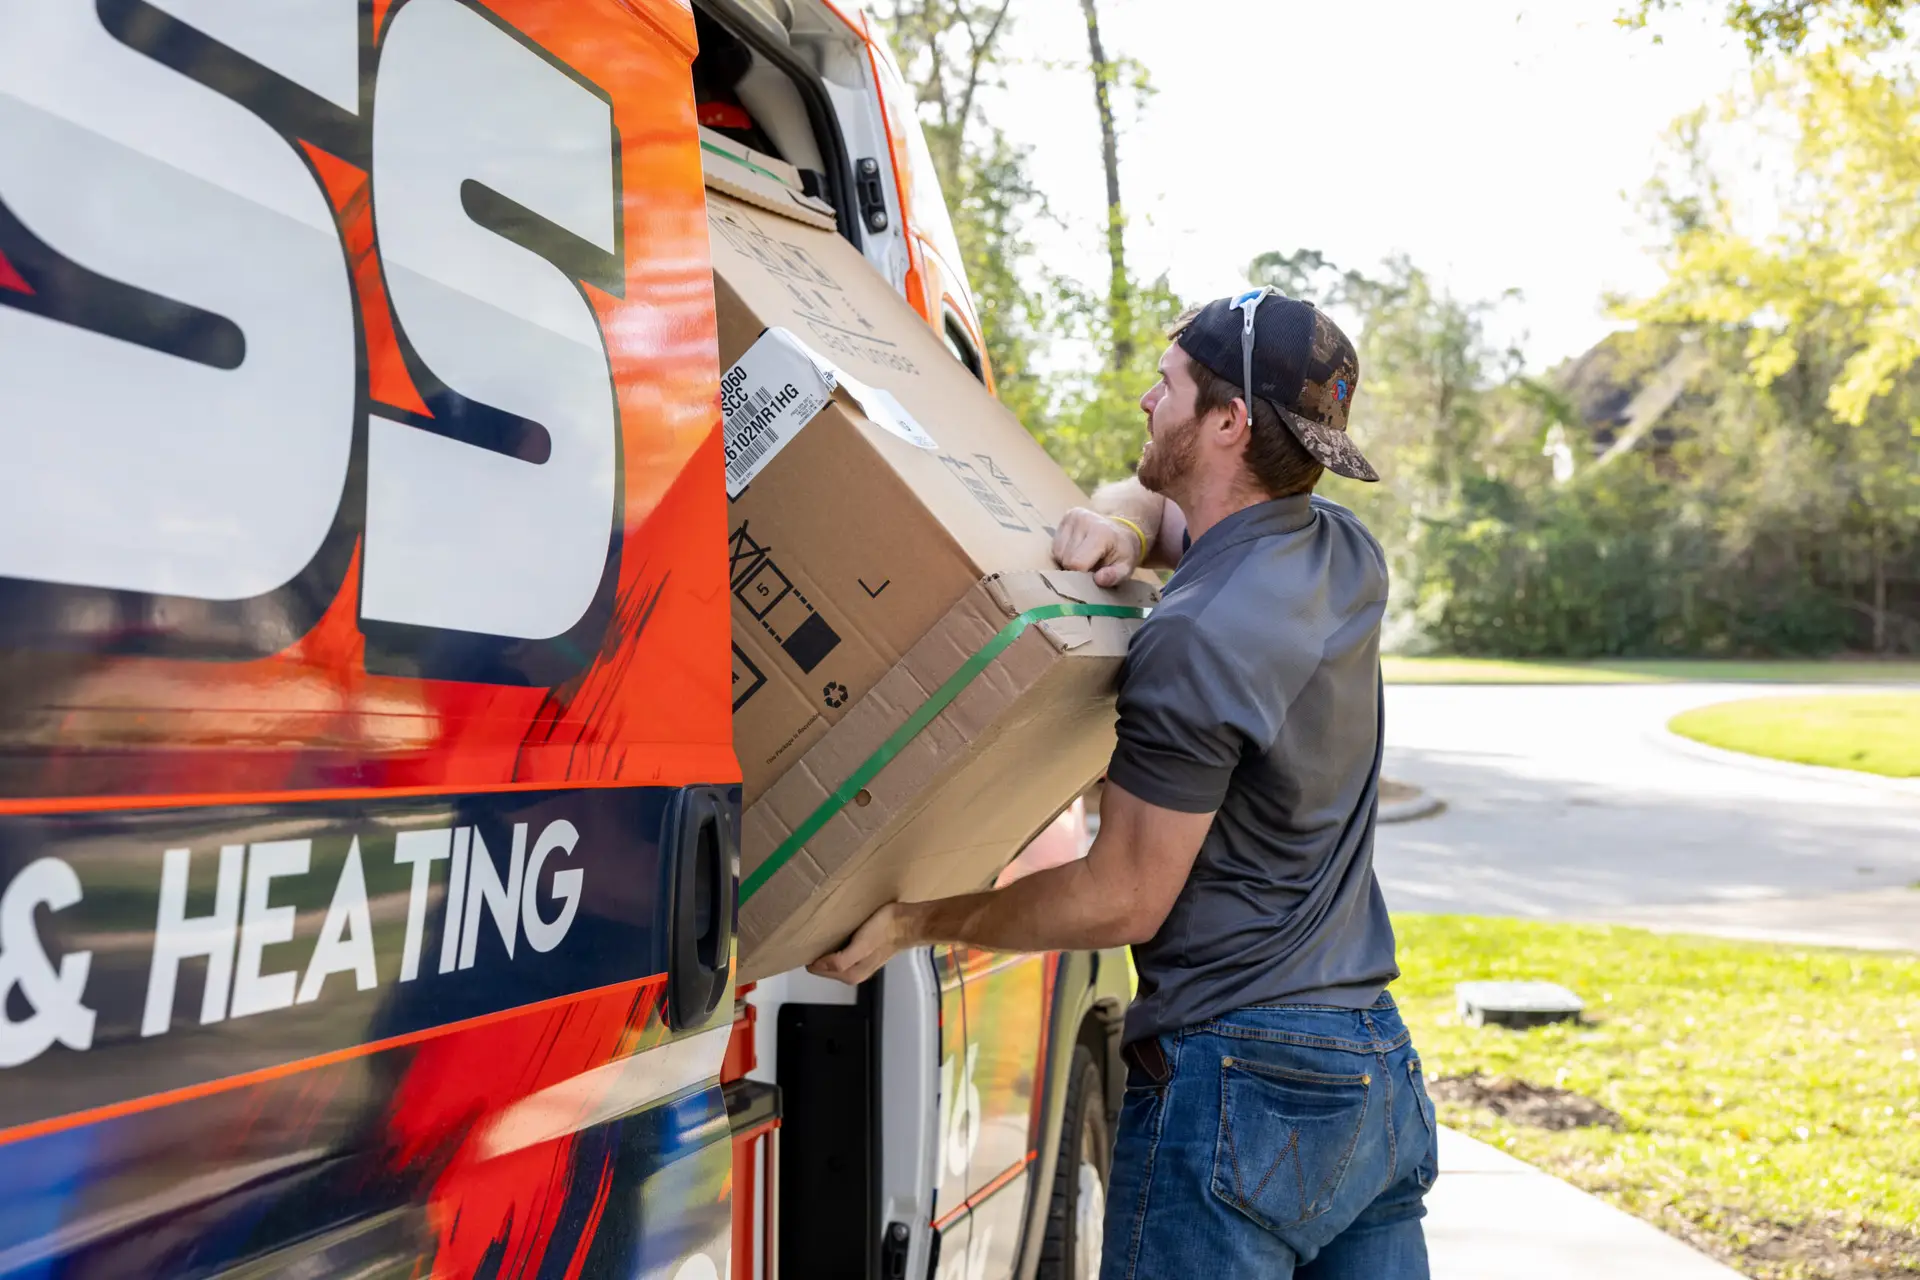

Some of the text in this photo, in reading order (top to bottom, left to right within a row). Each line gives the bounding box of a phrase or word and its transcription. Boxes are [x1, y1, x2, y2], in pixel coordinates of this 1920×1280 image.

[722, 387, 748, 417] SCC
[756, 582, 770, 597] 5
[0, 818, 584, 1068] & HEATING
